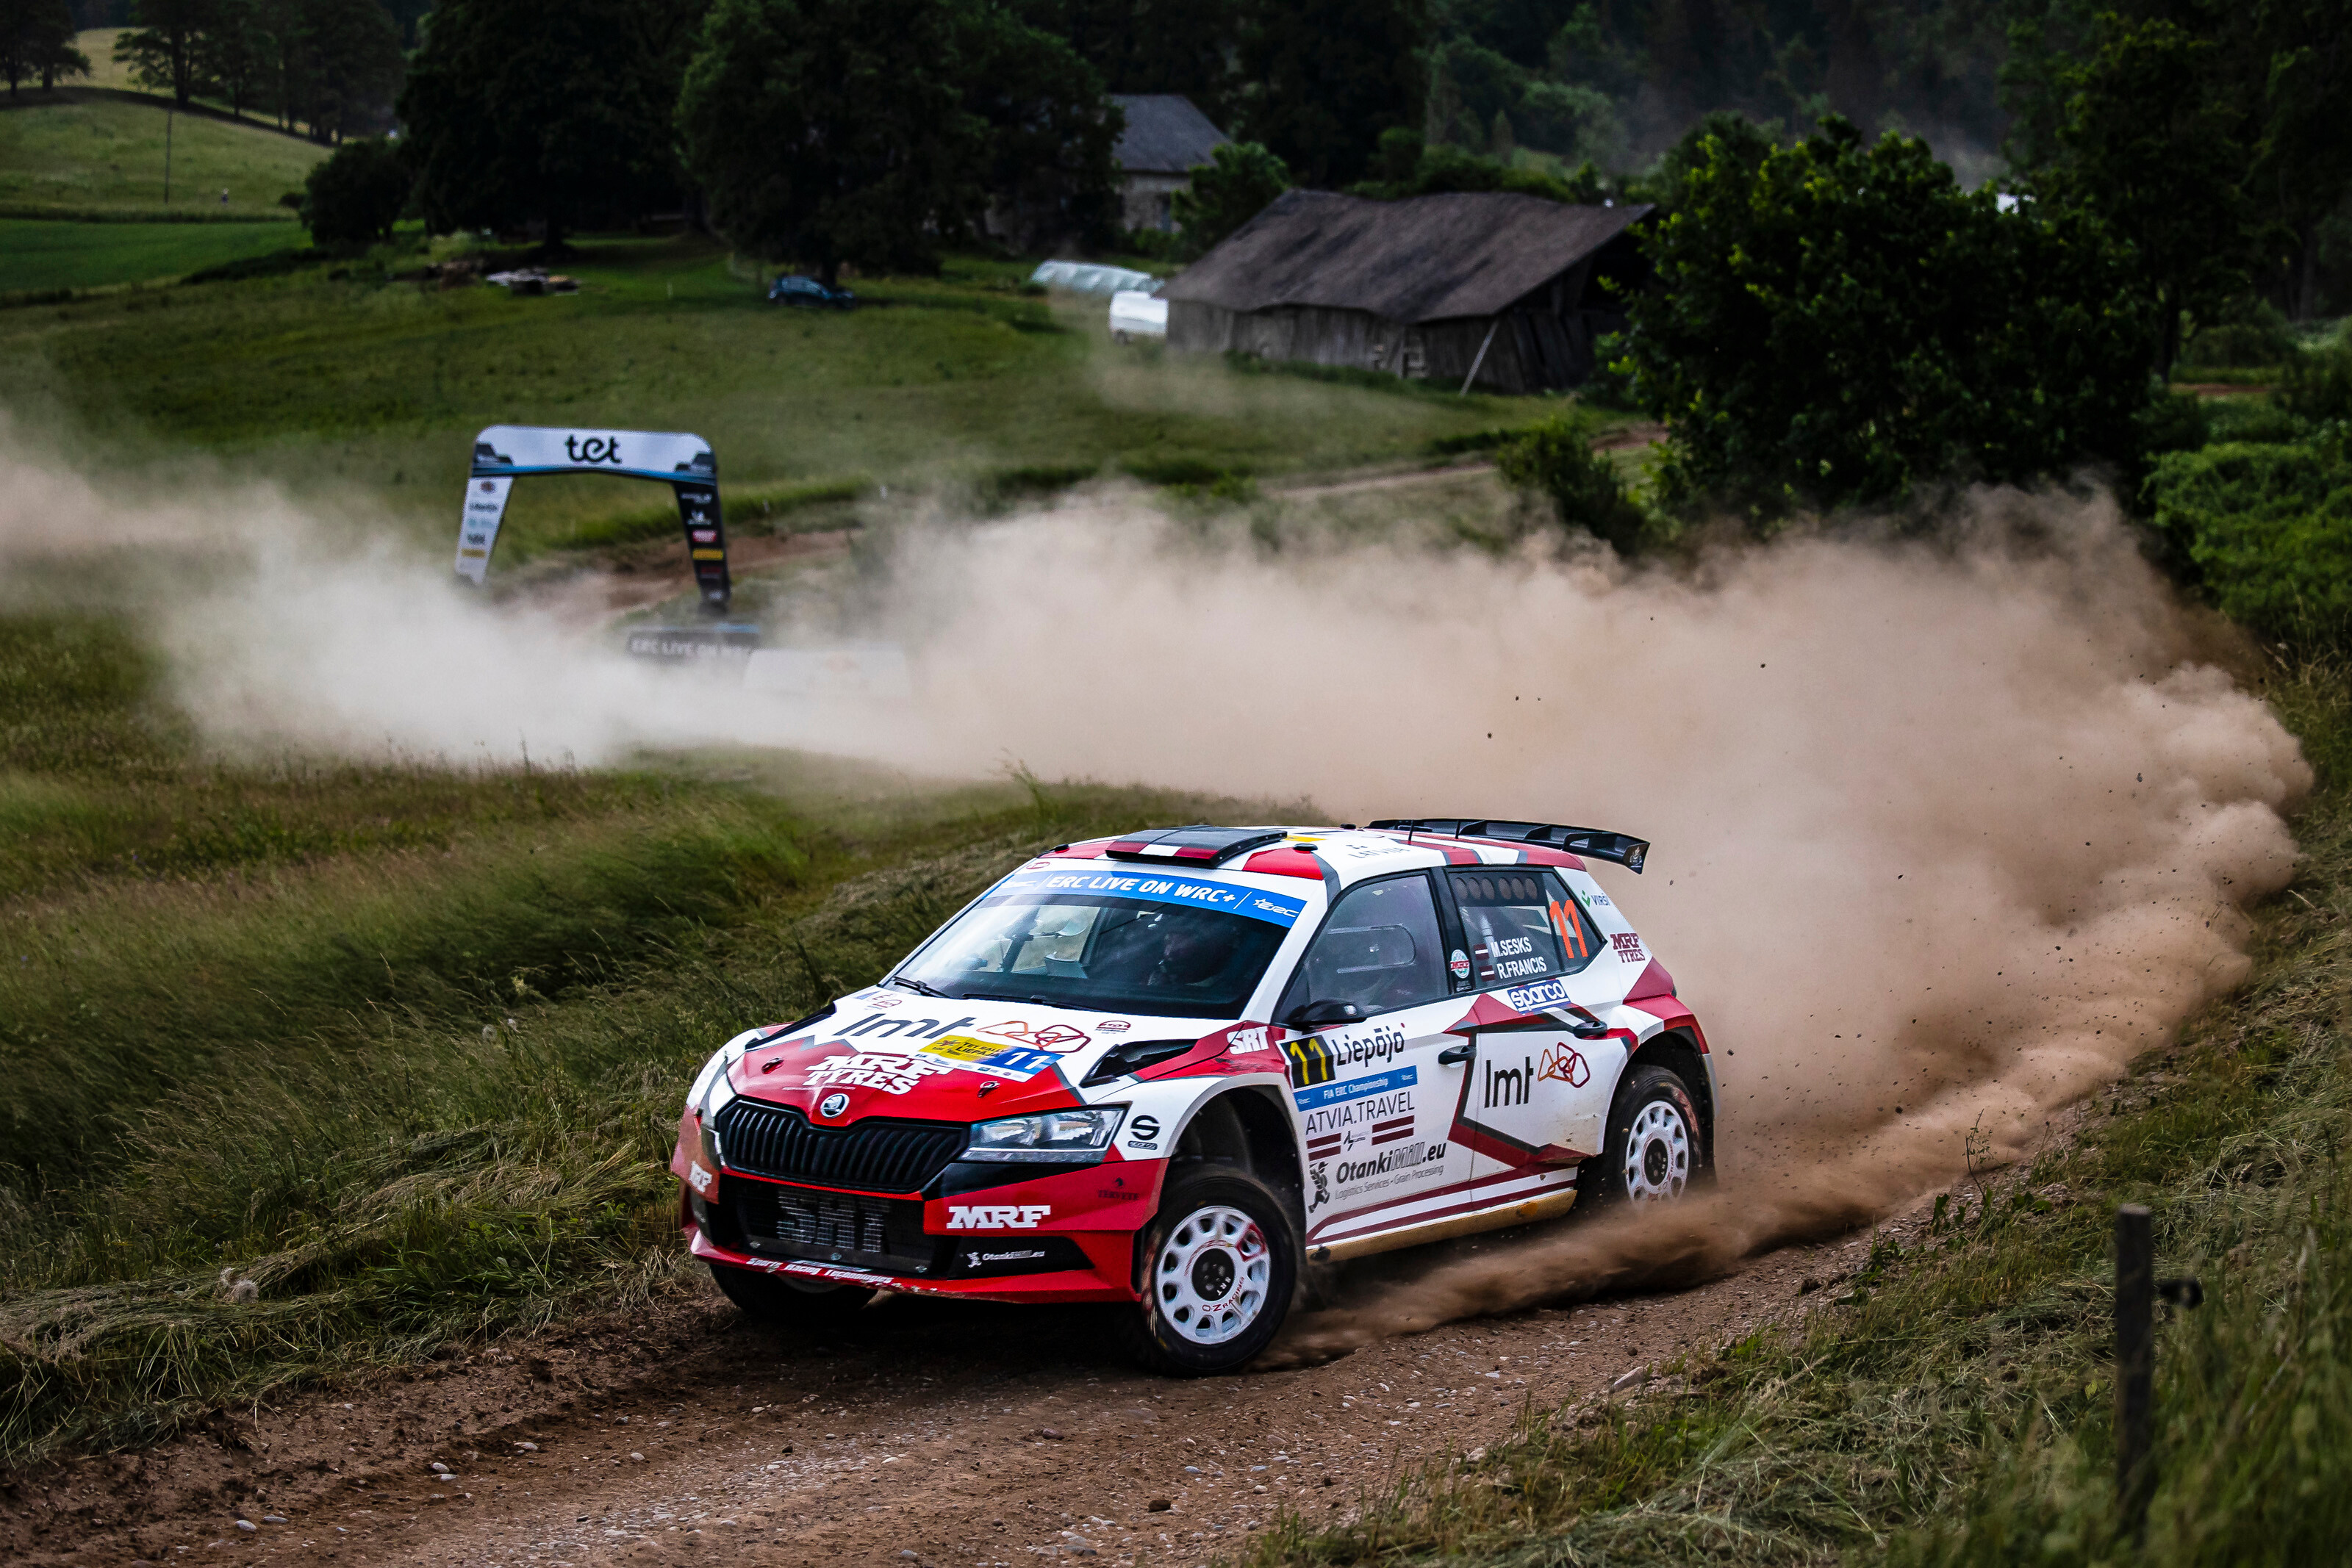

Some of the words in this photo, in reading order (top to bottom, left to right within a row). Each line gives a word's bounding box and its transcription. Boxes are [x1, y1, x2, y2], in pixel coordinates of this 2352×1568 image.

[565, 434, 622, 464] tet
[1046, 876, 1093, 888] ERC
[1088, 877, 1140, 891] LIVE
[1138, 880, 1175, 894] ON
[1174, 883, 1236, 902] WRC+
[1549, 899, 1588, 959] 11
[1610, 932, 1640, 950] MRF
[1490, 937, 1532, 957] M.SESKS
[1618, 949, 1646, 963] TYRES
[1498, 957, 1547, 979] R.FRANCIS
[1510, 982, 1566, 1012] sparco
[831, 1013, 978, 1039] lmt
[1226, 1026, 1269, 1055] SRT
[805, 1054, 955, 1080] MRF
[1004, 1051, 1051, 1070] 11
[1289, 1037, 1328, 1085] 11
[802, 1069, 920, 1095] TYRES
[1323, 1089, 1335, 1099] FIA
[1484, 1056, 1534, 1109] lmt
[946, 1205, 1051, 1229] MRF
[784, 1263, 822, 1276] Racing
